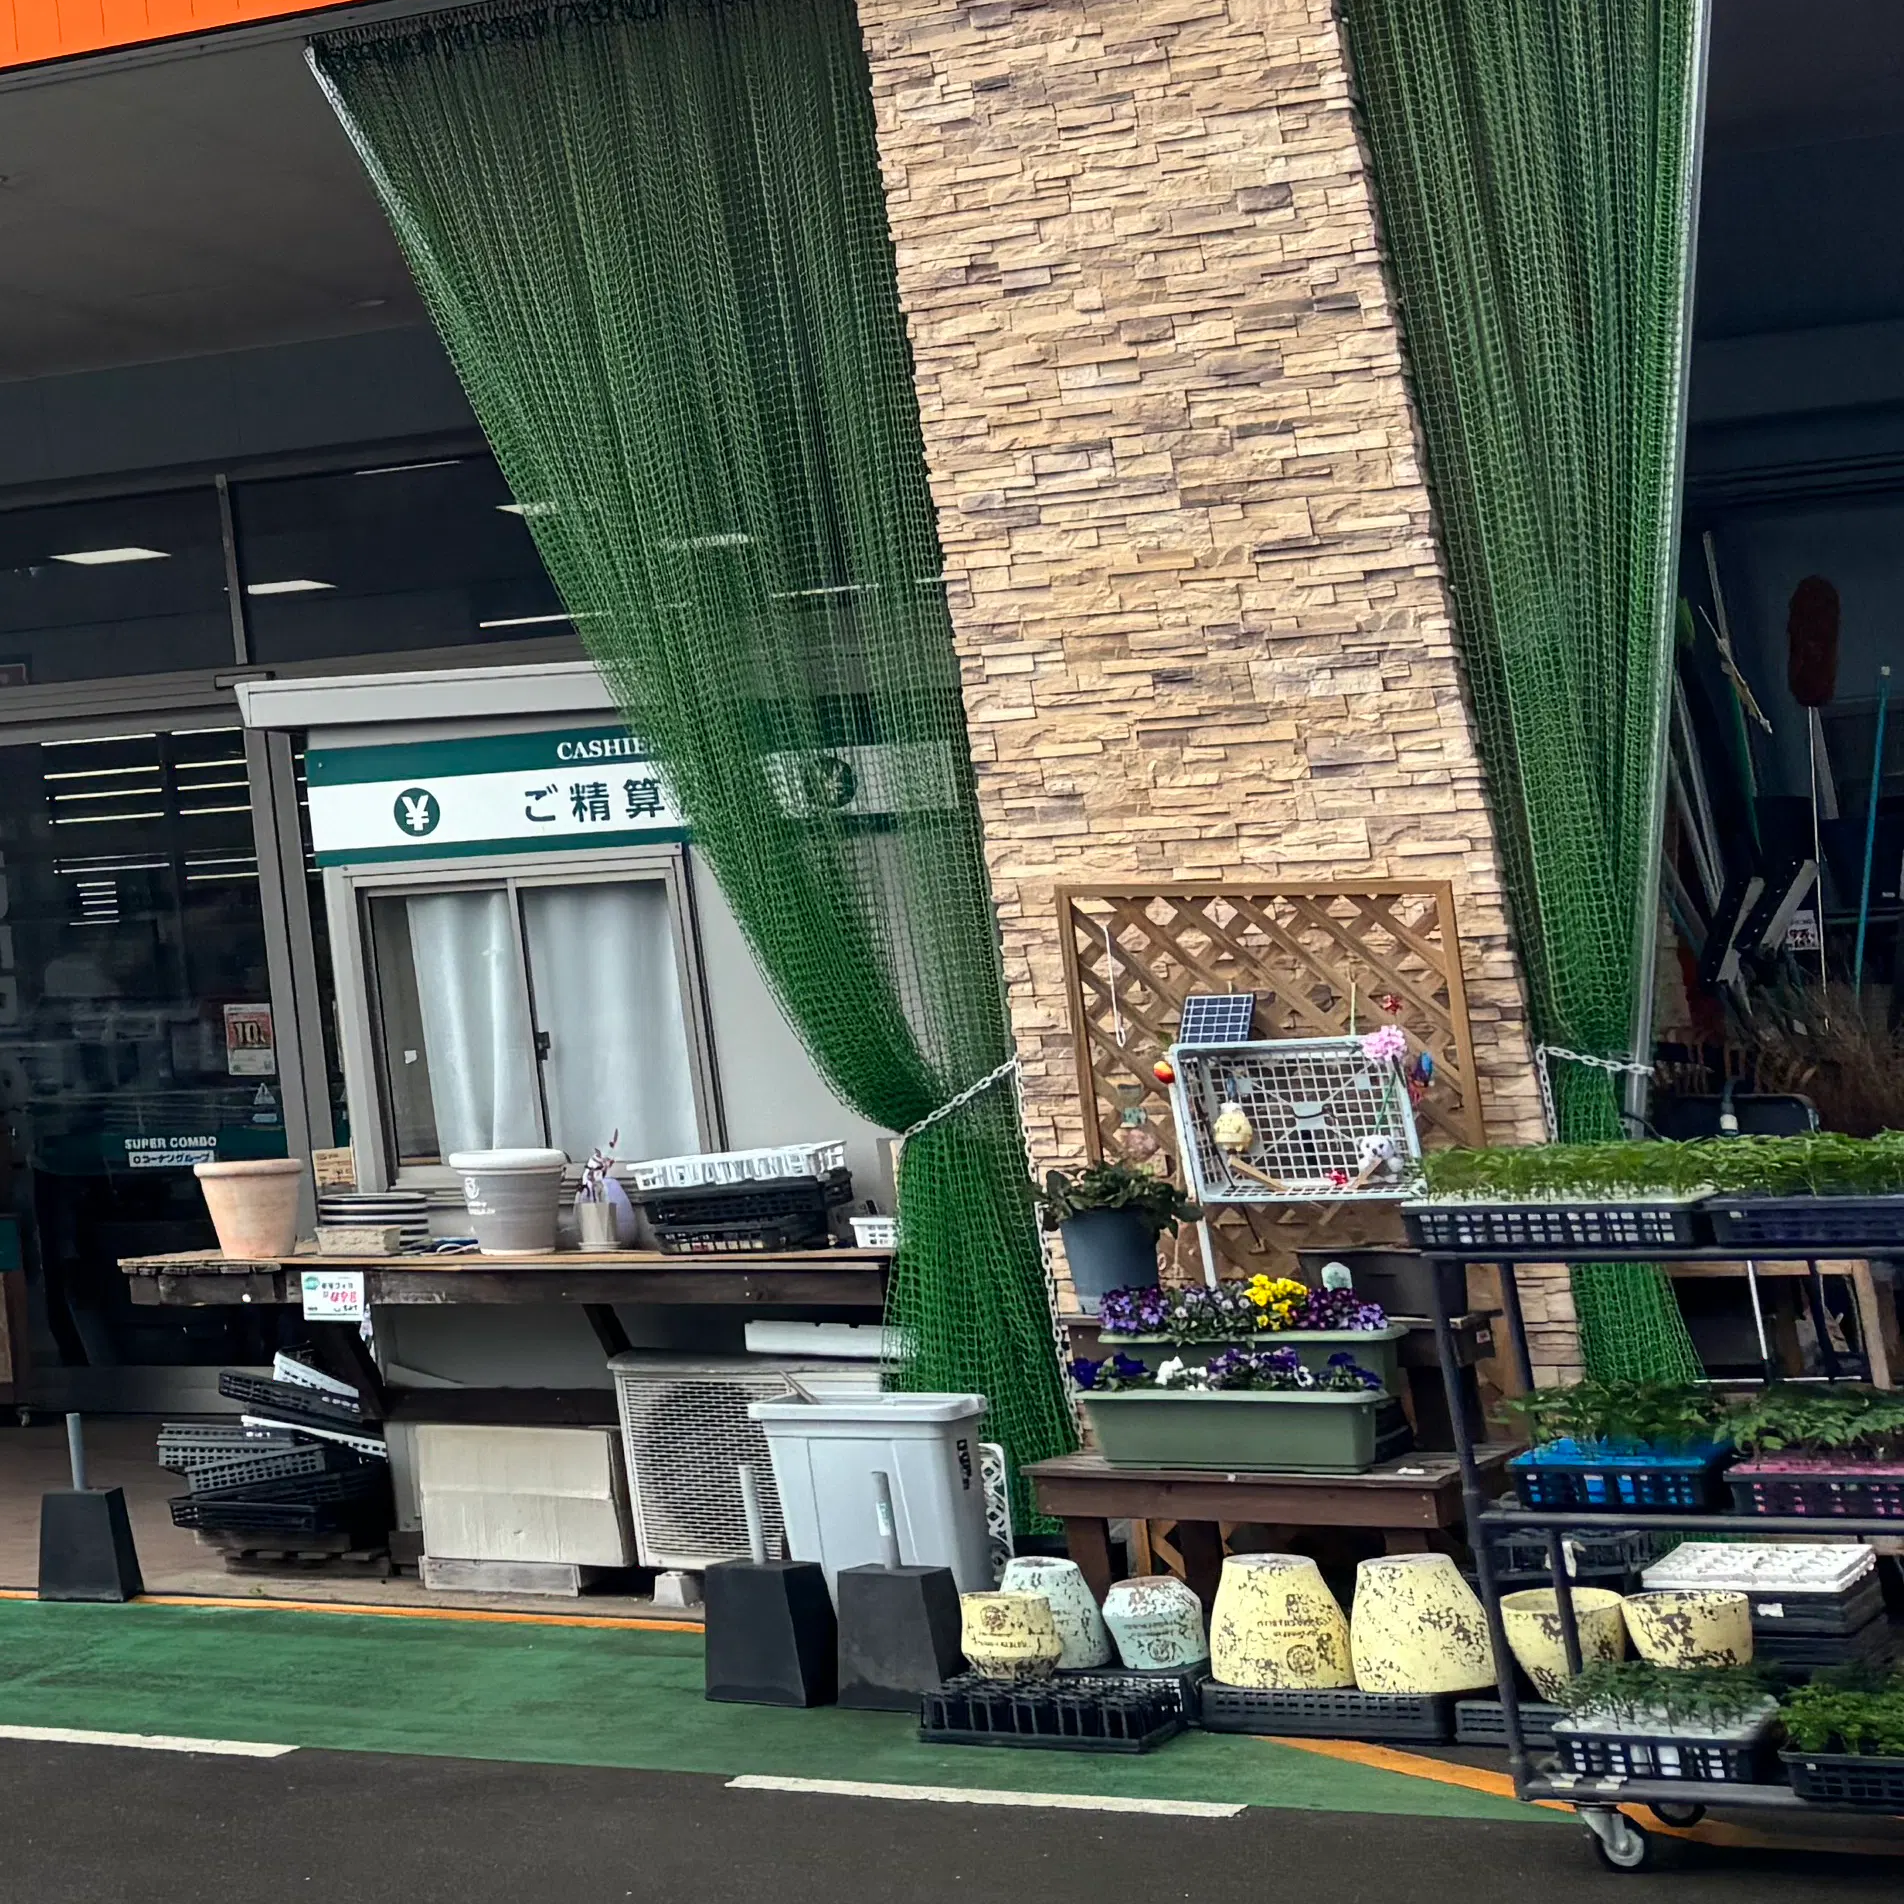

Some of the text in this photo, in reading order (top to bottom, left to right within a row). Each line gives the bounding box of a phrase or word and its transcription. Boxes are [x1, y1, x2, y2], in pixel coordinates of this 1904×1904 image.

[556, 734, 654, 761] CASHIE
[524, 776, 667, 824] ご精算
[124, 1136, 217, 1150] SUPER COMBO
